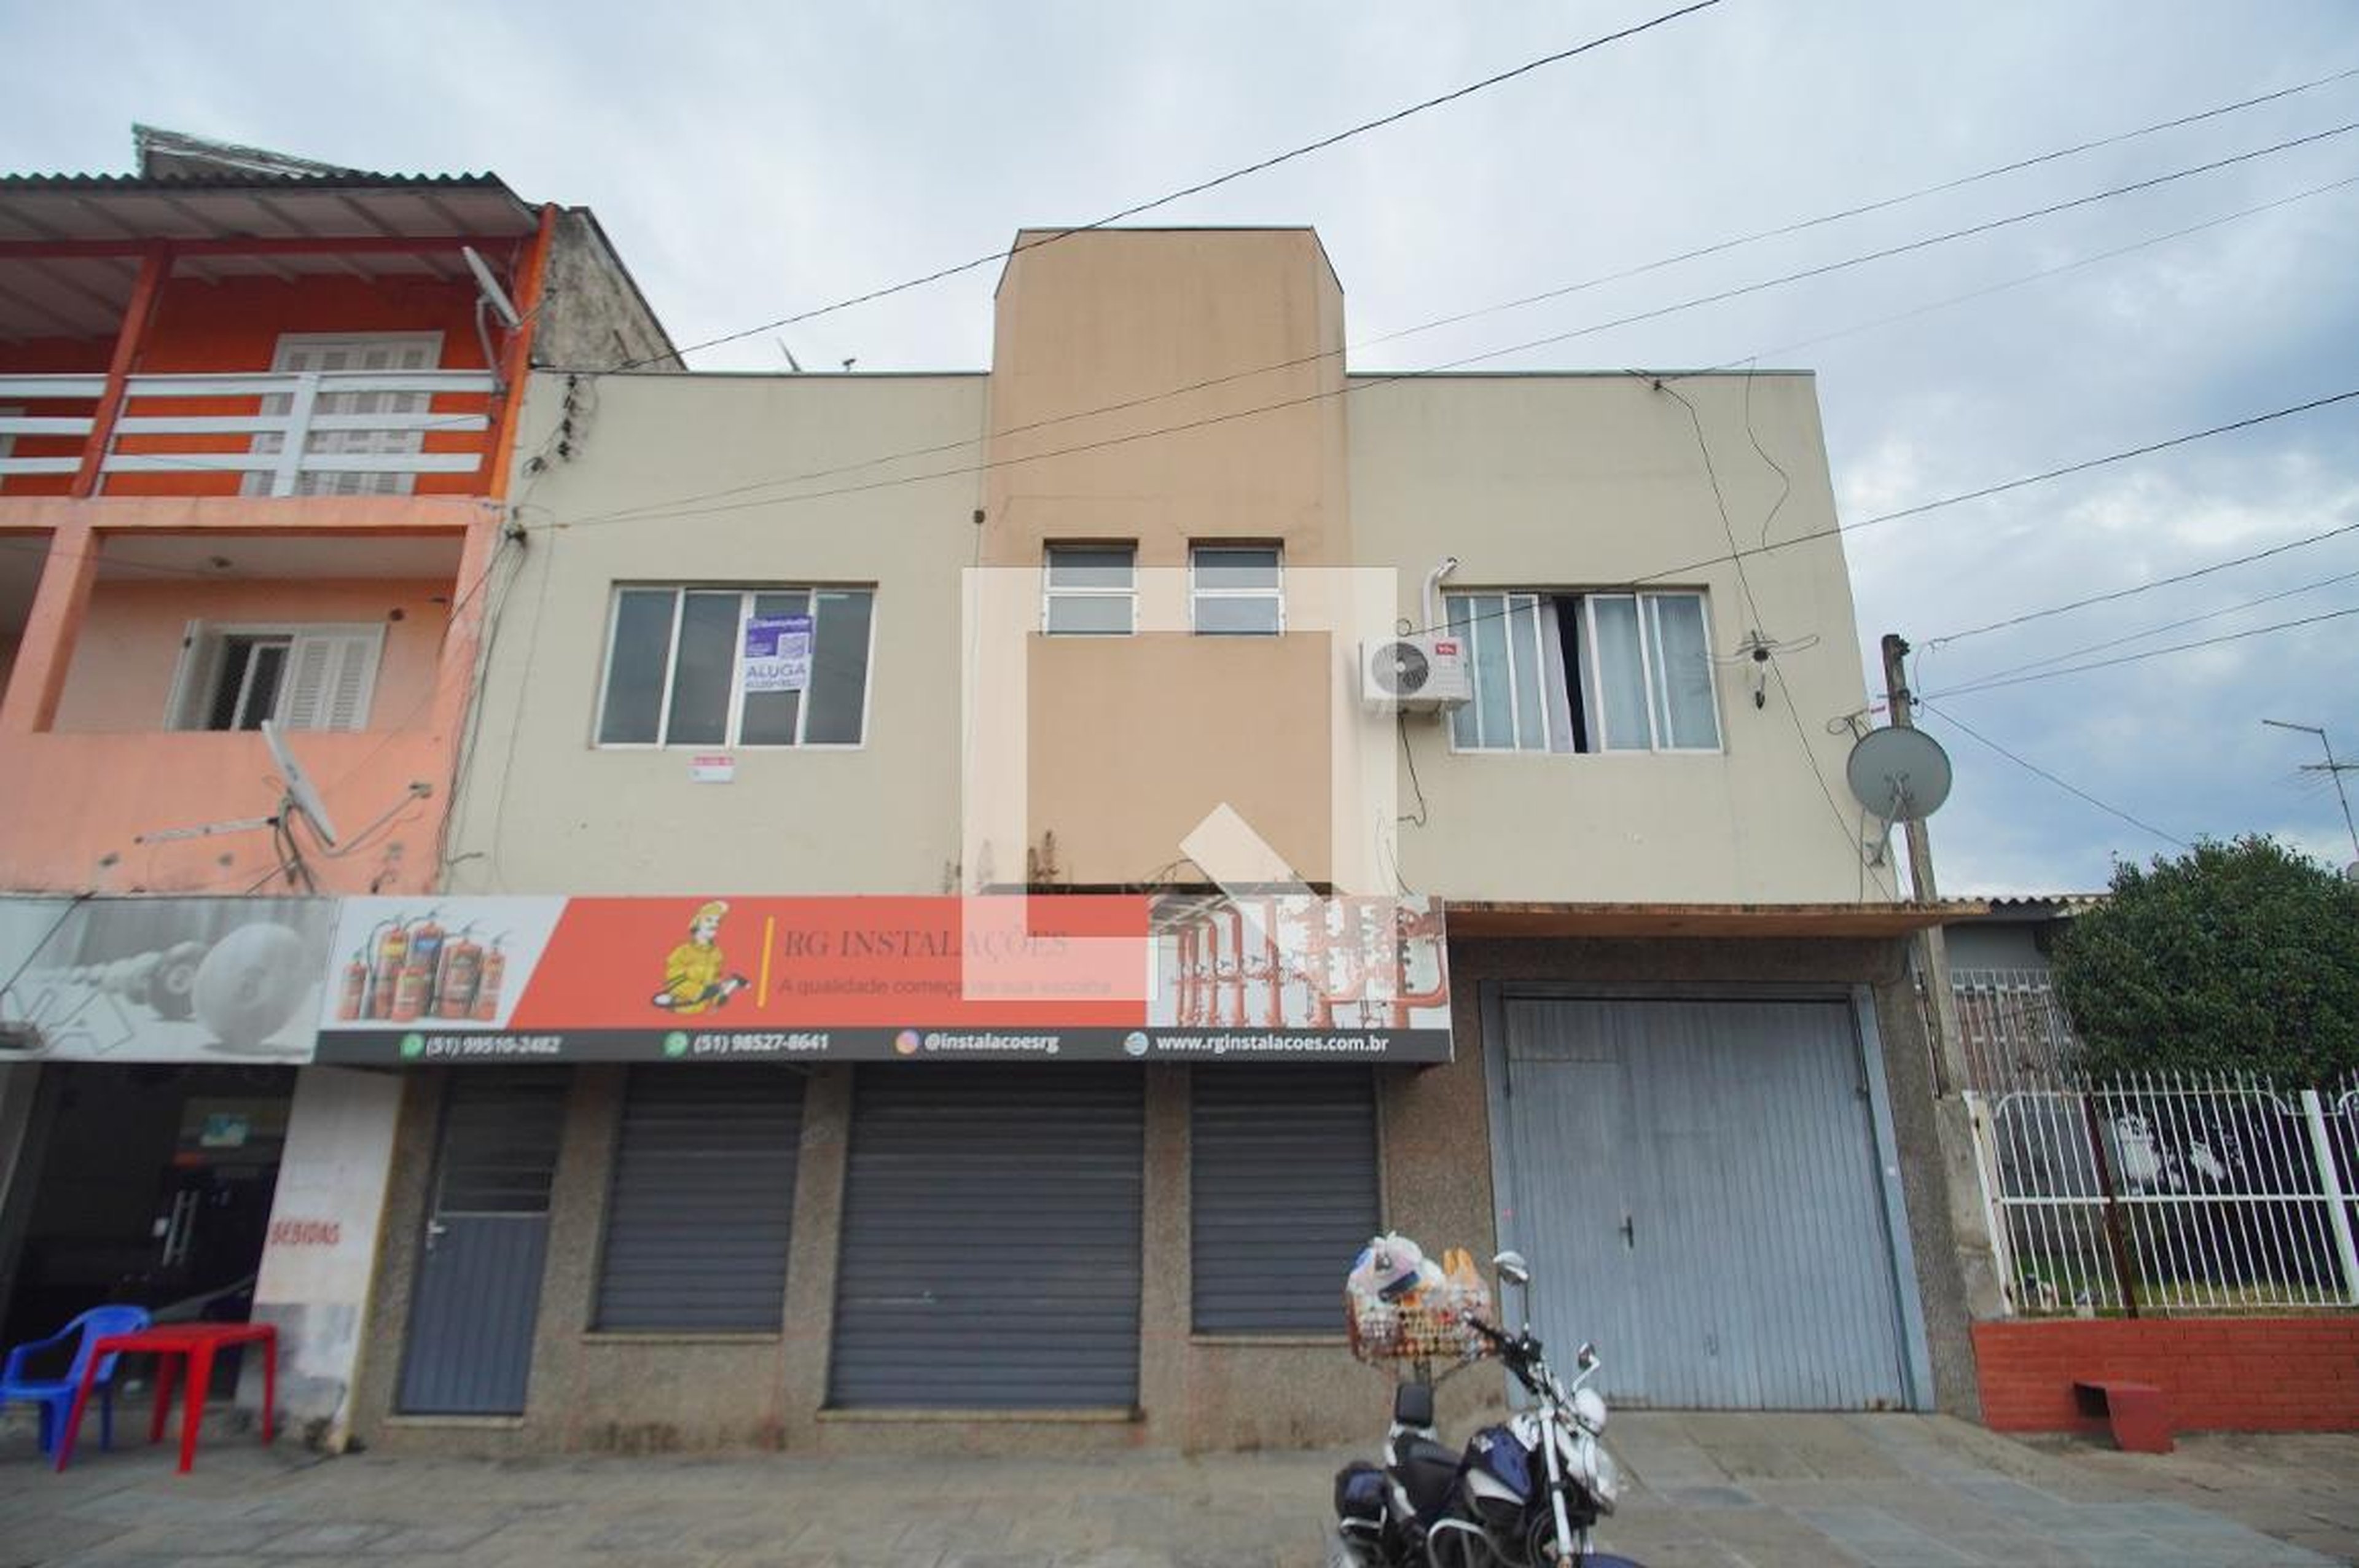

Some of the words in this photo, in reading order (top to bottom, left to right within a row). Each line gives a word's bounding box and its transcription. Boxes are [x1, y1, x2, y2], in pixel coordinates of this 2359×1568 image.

[747, 663, 807, 679] ALUGA
[785, 930, 829, 957] RG
[841, 924, 1068, 963] INSTALAÇÕES
[693, 1034, 729, 1054] (51)
[925, 1032, 1060, 1054] @instalacoesrg
[1156, 1034, 1389, 1053] www.rginstalacoes.com.br
